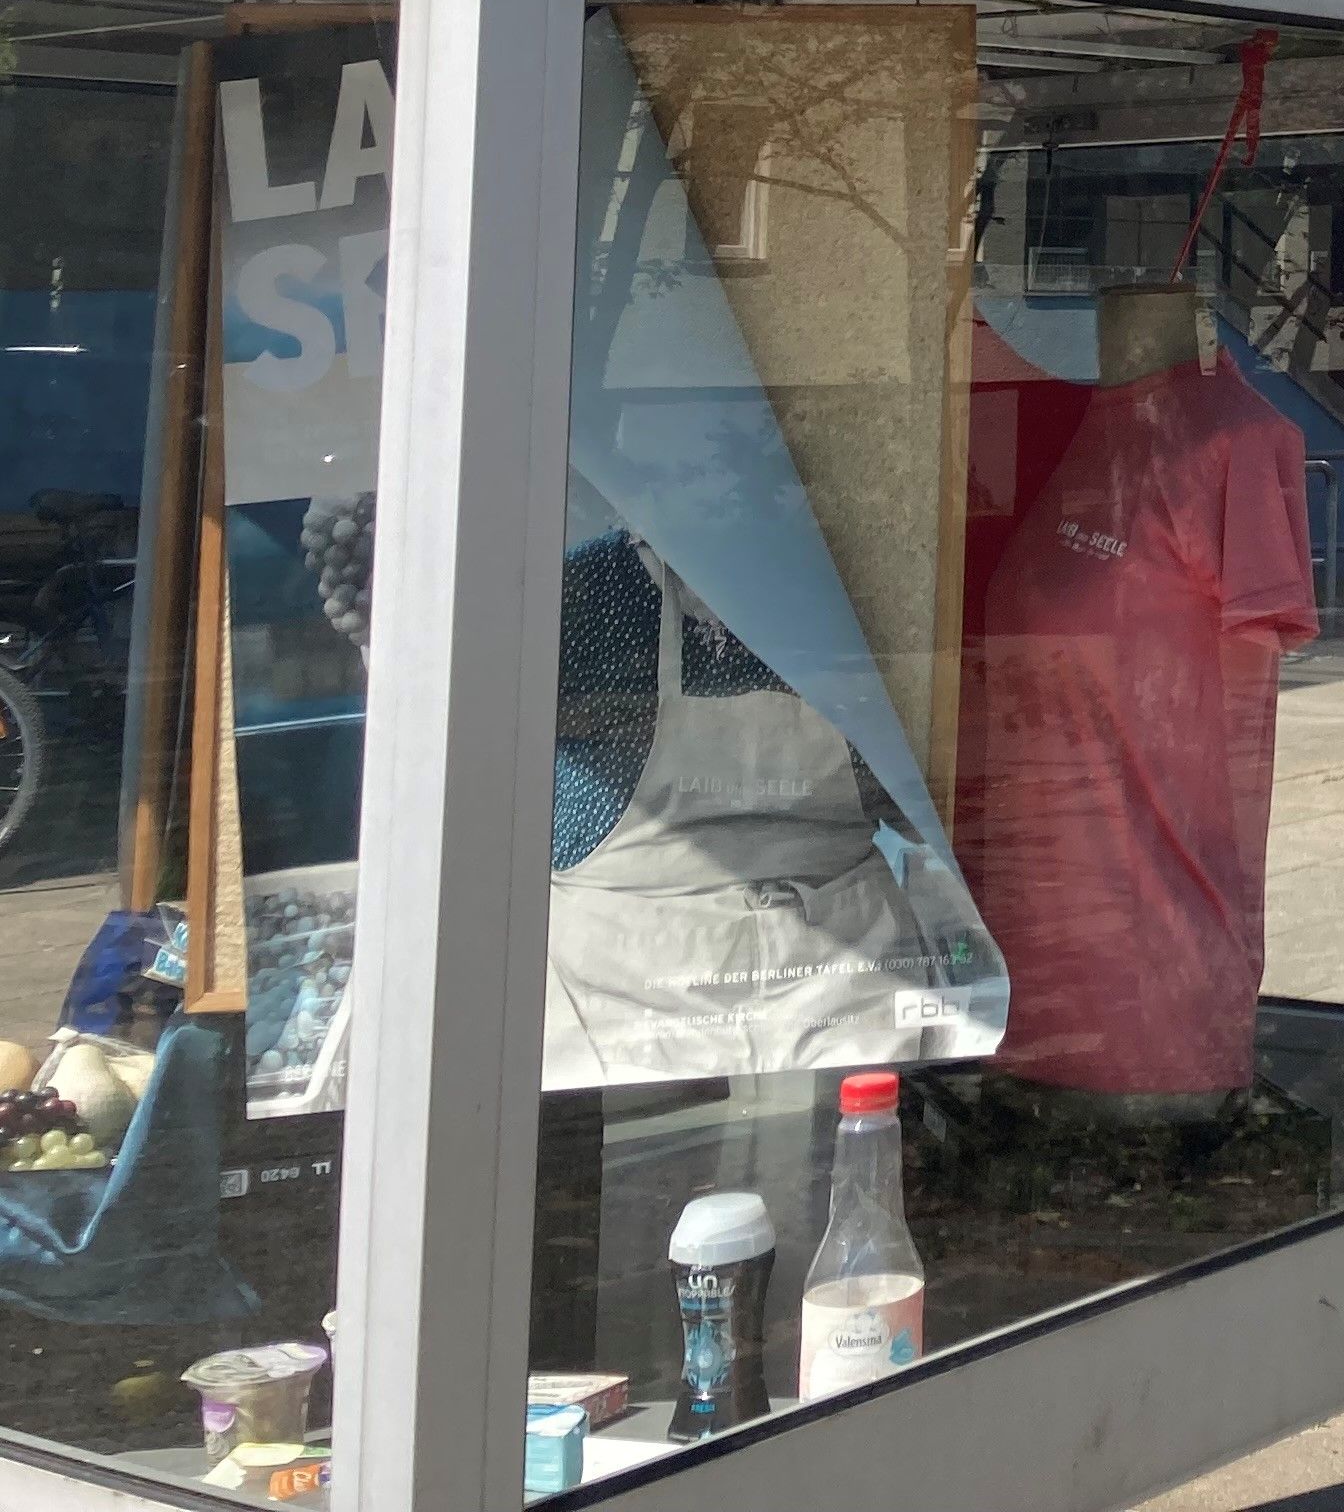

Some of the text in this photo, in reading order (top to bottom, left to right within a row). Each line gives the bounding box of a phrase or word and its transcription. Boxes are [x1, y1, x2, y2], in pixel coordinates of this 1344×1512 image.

[723, 972, 748, 984] DER
[751, 965, 812, 983] BERLINER
[815, 963, 854, 976] TAFEL
[902, 995, 961, 1021] rbb
[835, 1335, 882, 1349] Valensina
